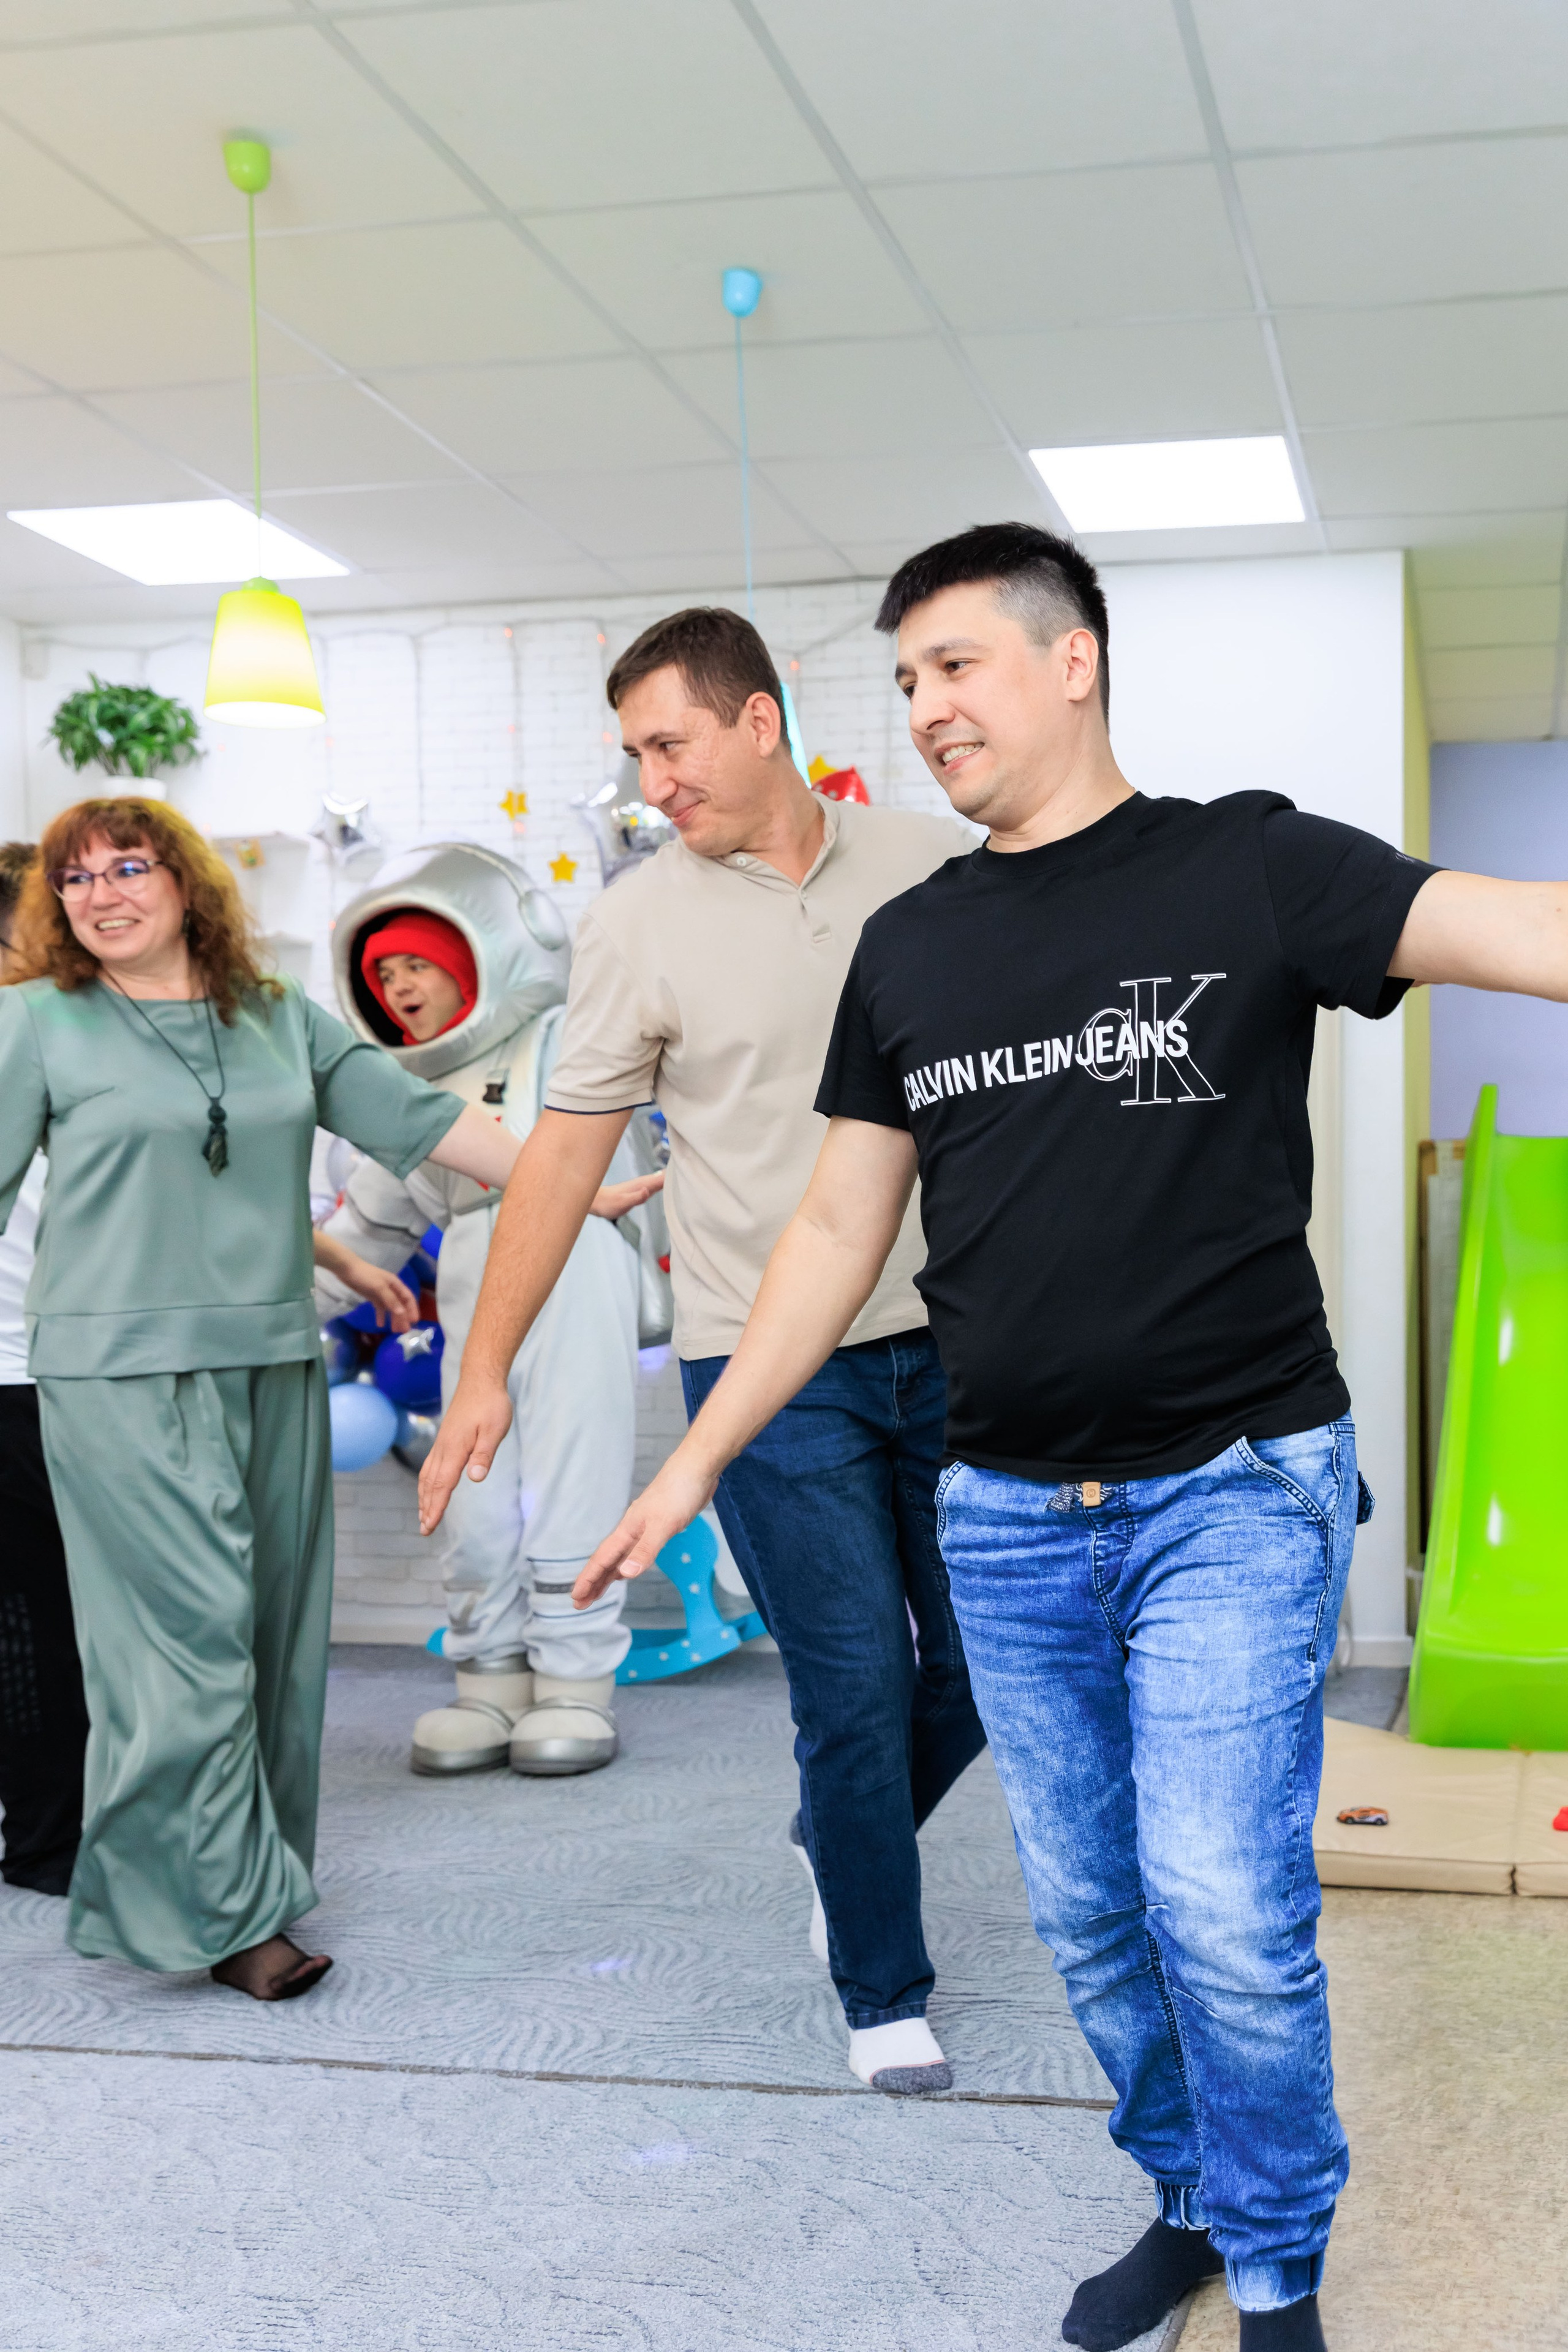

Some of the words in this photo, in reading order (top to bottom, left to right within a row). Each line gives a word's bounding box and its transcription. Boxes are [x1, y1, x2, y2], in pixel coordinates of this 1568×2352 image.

[903, 1055, 977, 1112] CALVIN
[980, 1035, 1073, 1088] KLEIN
[1075, 1019, 1189, 1066] JEANS
